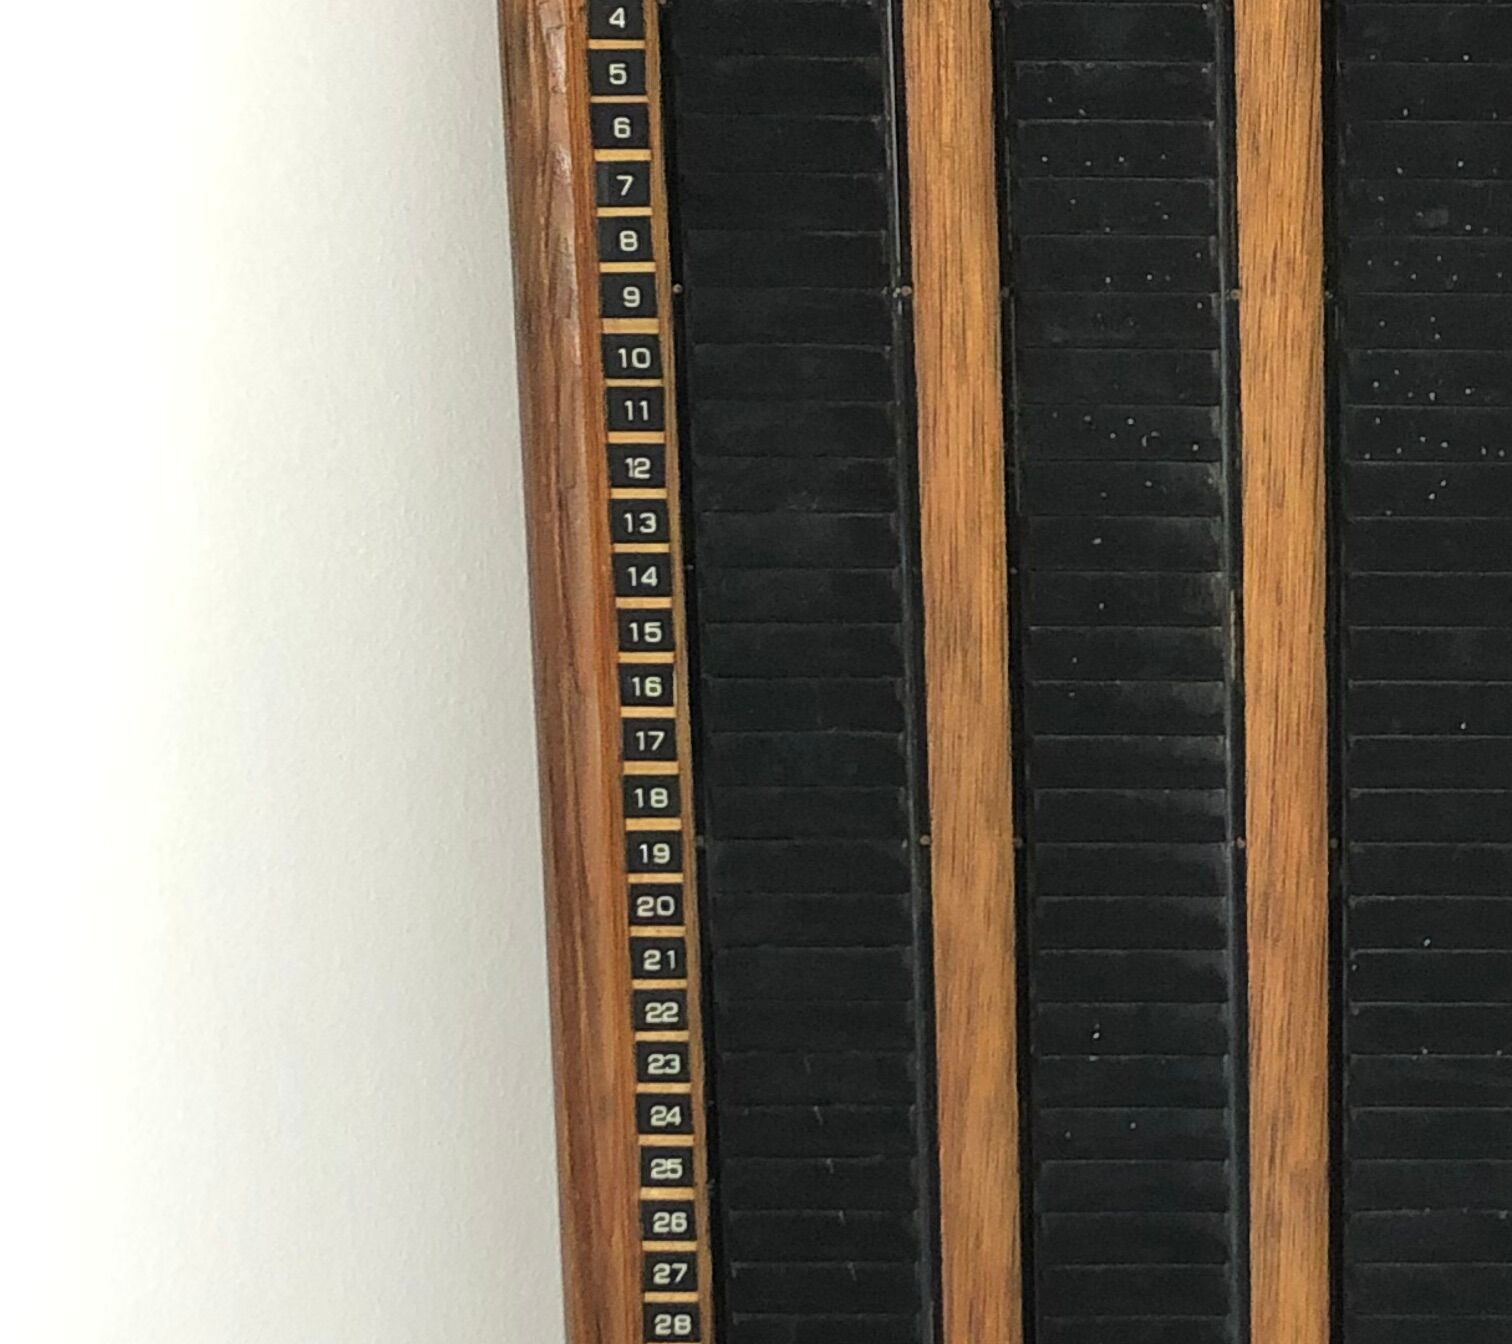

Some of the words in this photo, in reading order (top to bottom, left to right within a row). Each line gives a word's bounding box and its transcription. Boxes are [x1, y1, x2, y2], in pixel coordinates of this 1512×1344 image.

[607, 6, 627, 30] 4
[608, 62, 628, 86] 5
[612, 116, 632, 140] 6
[615, 174, 634, 197] 7
[618, 229, 639, 253] 8
[622, 285, 642, 309] 9
[617, 346, 652, 370] 10
[623, 399, 650, 422] 11
[624, 456, 652, 480] 12
[623, 511, 658, 534] 13
[626, 565, 659, 588] 14
[628, 620, 663, 644] 15
[630, 675, 663, 698] 16
[635, 730, 666, 752] 17
[633, 786, 670, 809] 18
[638, 842, 671, 865] 19
[635, 894, 676, 918] 20
[642, 948, 676, 972] 21
[644, 1000, 680, 1025] 22
[646, 1052, 682, 1076] 23
[649, 1104, 683, 1127] 24
[649, 1157, 684, 1181] 25
[652, 1210, 689, 1234] 26
[652, 1261, 689, 1285] 27
[653, 1313, 693, 1336] 28
